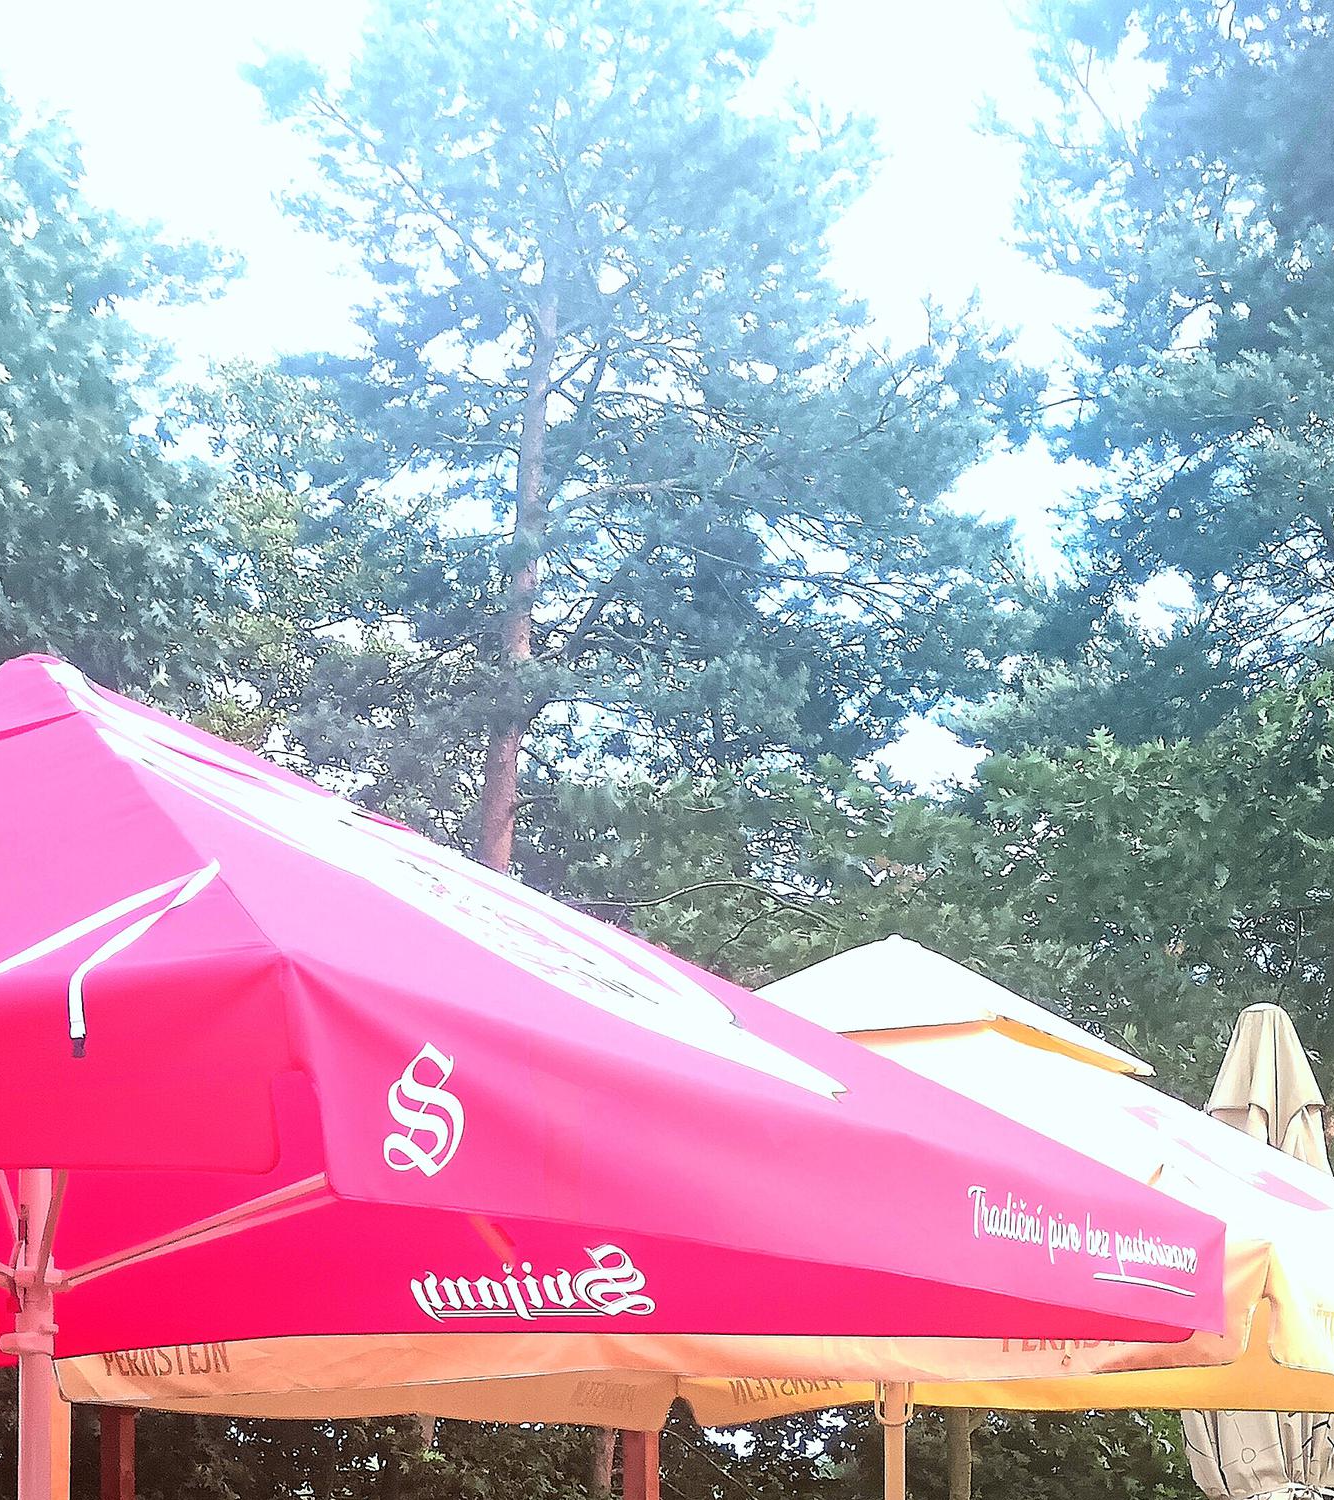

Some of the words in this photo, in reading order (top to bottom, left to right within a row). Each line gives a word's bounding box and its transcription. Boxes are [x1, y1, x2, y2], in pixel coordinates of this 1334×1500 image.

[382, 1041, 465, 1178] S
[967, 1185, 1044, 1246] Tradiční
[1048, 1213, 1082, 1264] pivo
[1085, 1213, 1111, 1259] bez
